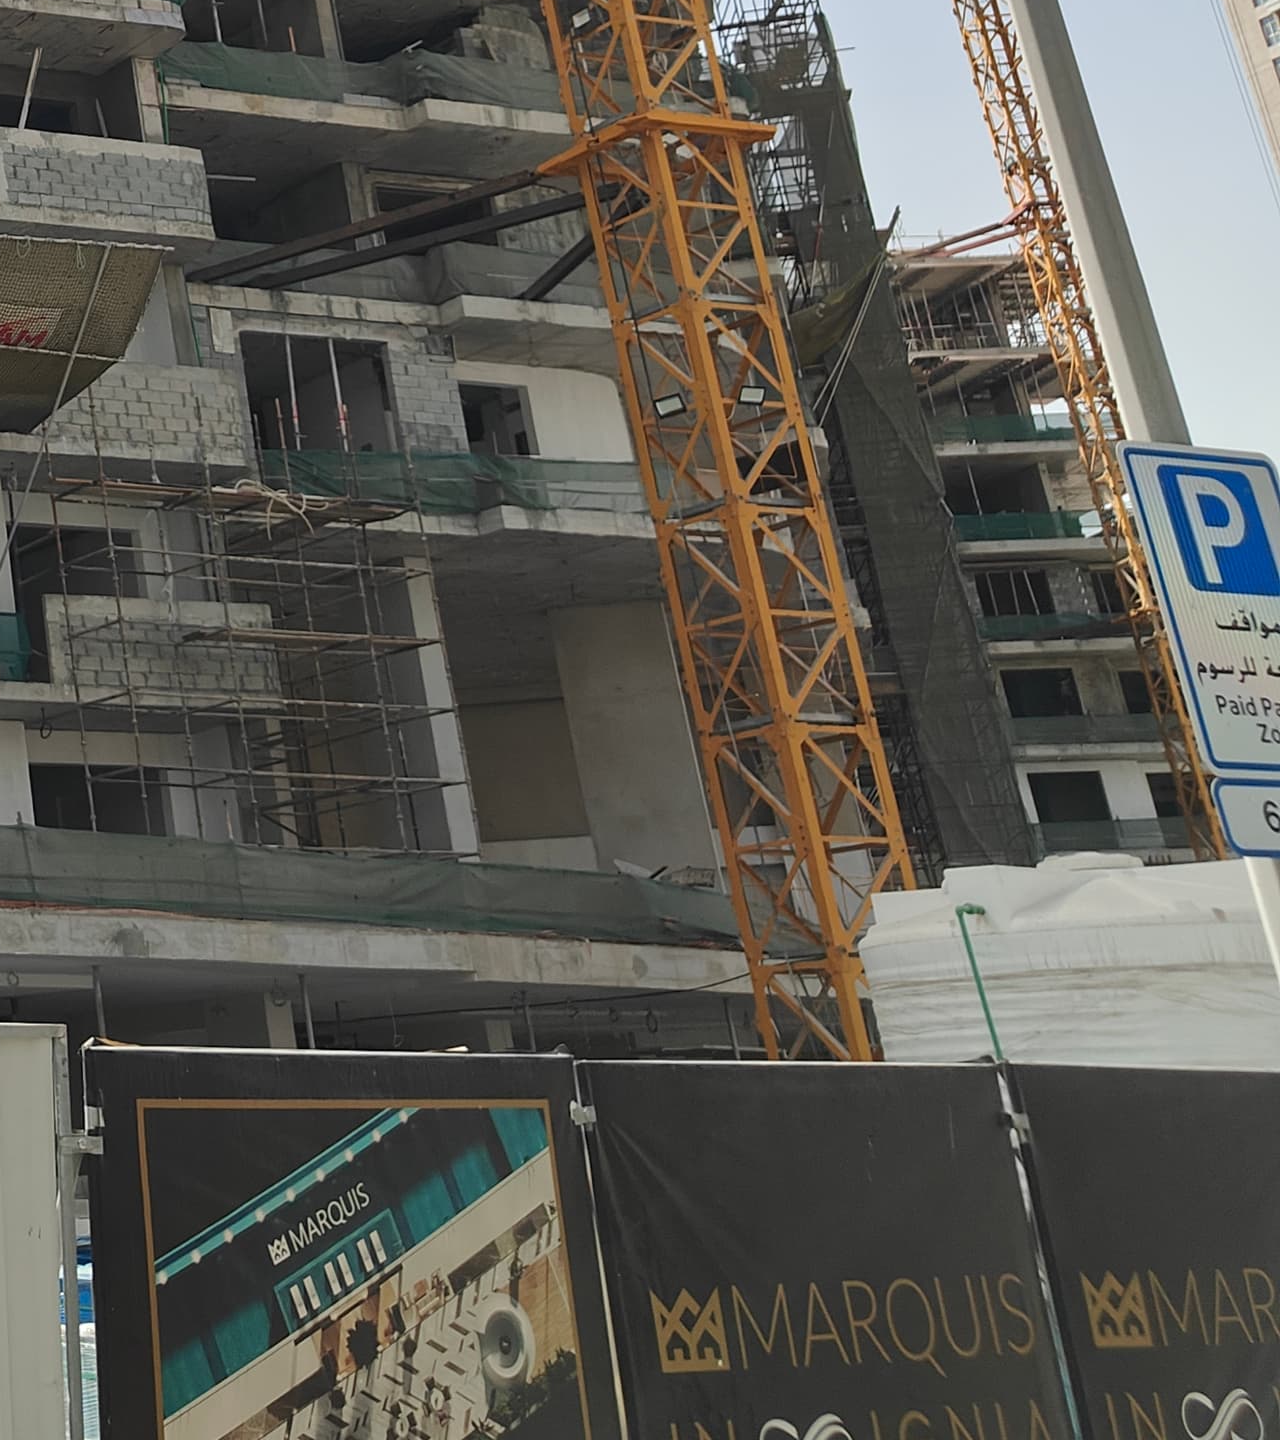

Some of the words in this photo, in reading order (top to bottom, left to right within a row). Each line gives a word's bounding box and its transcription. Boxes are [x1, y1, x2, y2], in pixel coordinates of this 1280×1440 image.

[1176, 474, 1245, 584] P
[1197, 656, 1257, 687] للرسوم
[1215, 695, 1258, 716] Paid
[288, 1182, 371, 1252] MARQUIS
[731, 1273, 1036, 1378] MARQUIS
